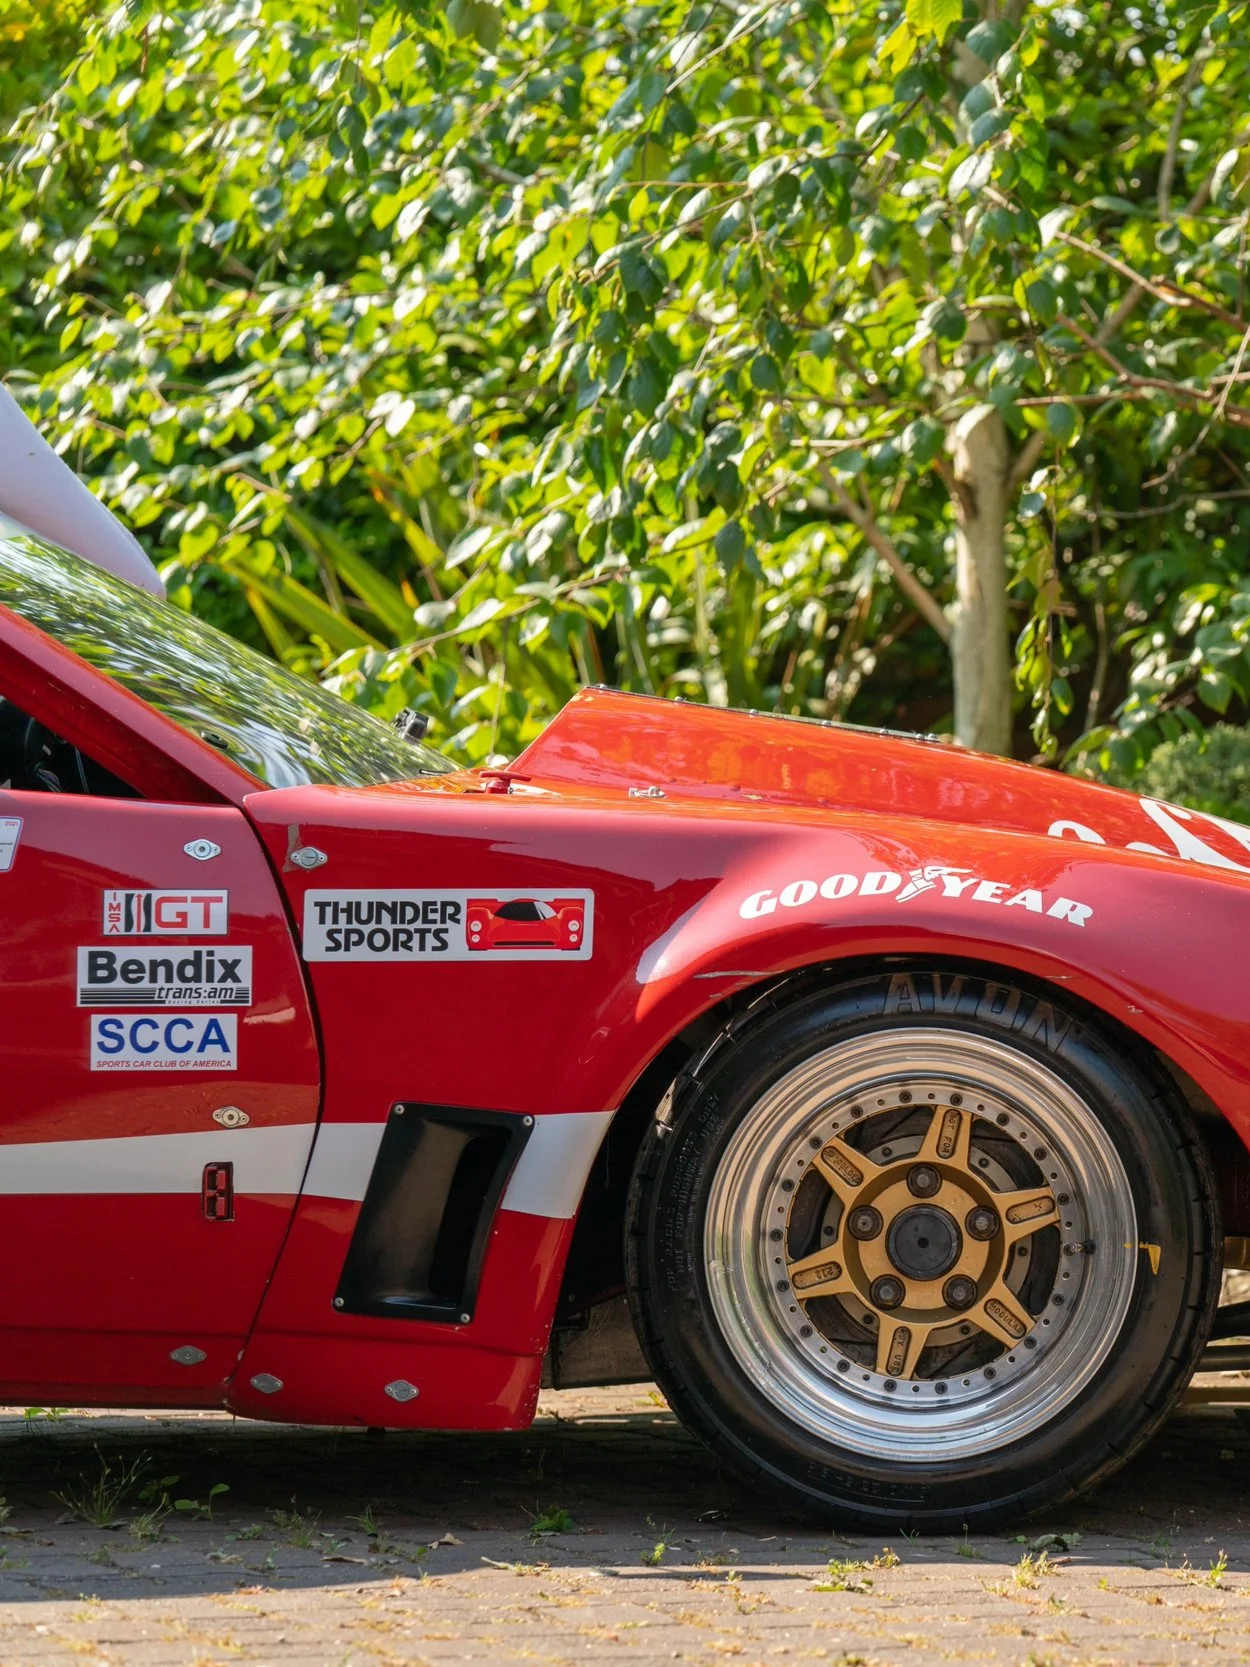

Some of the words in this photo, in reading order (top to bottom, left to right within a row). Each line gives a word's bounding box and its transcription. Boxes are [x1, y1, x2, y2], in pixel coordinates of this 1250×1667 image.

[108, 892, 121, 933] IMSA
[155, 896, 223, 929] GT
[314, 901, 461, 926] THUNDER
[325, 928, 449, 952] SPORTS
[88, 950, 242, 985] Bendix
[157, 986, 234, 1000] trans:am
[882, 972, 1075, 1053] AVON
[97, 1018, 231, 1054] SCCA
[96, 1060, 131, 1068] SPORTS
[133, 1060, 151, 1068] CAR
[154, 1060, 177, 1068] CLUB
[179, 1060, 191, 1068] OF
[192, 1060, 232, 1068] AMERICA
